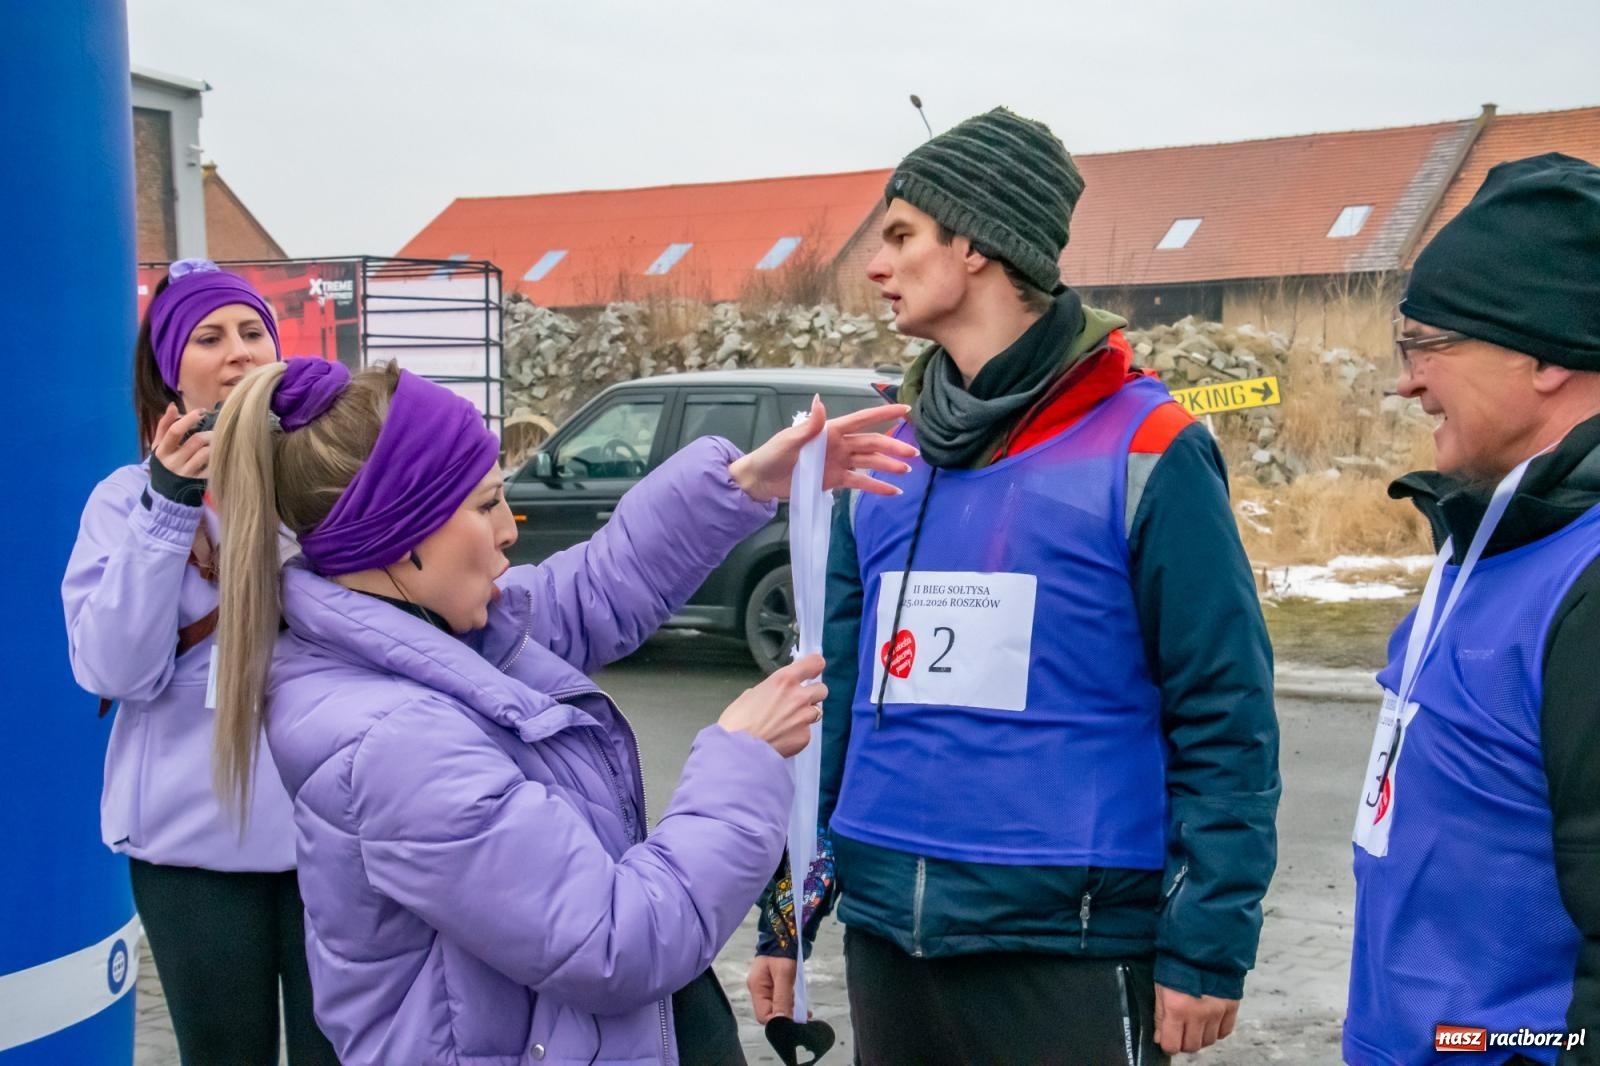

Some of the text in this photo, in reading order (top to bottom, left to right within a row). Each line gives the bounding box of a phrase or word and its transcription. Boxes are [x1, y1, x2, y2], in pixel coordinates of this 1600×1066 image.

[309, 278, 353, 295] XTREME
[913, 584, 990, 595] II BIEG SOŁTYSA
[950, 597, 1000, 608] ROSZKÓW
[928, 626, 955, 673] 2
[1366, 751, 1388, 808] 3
